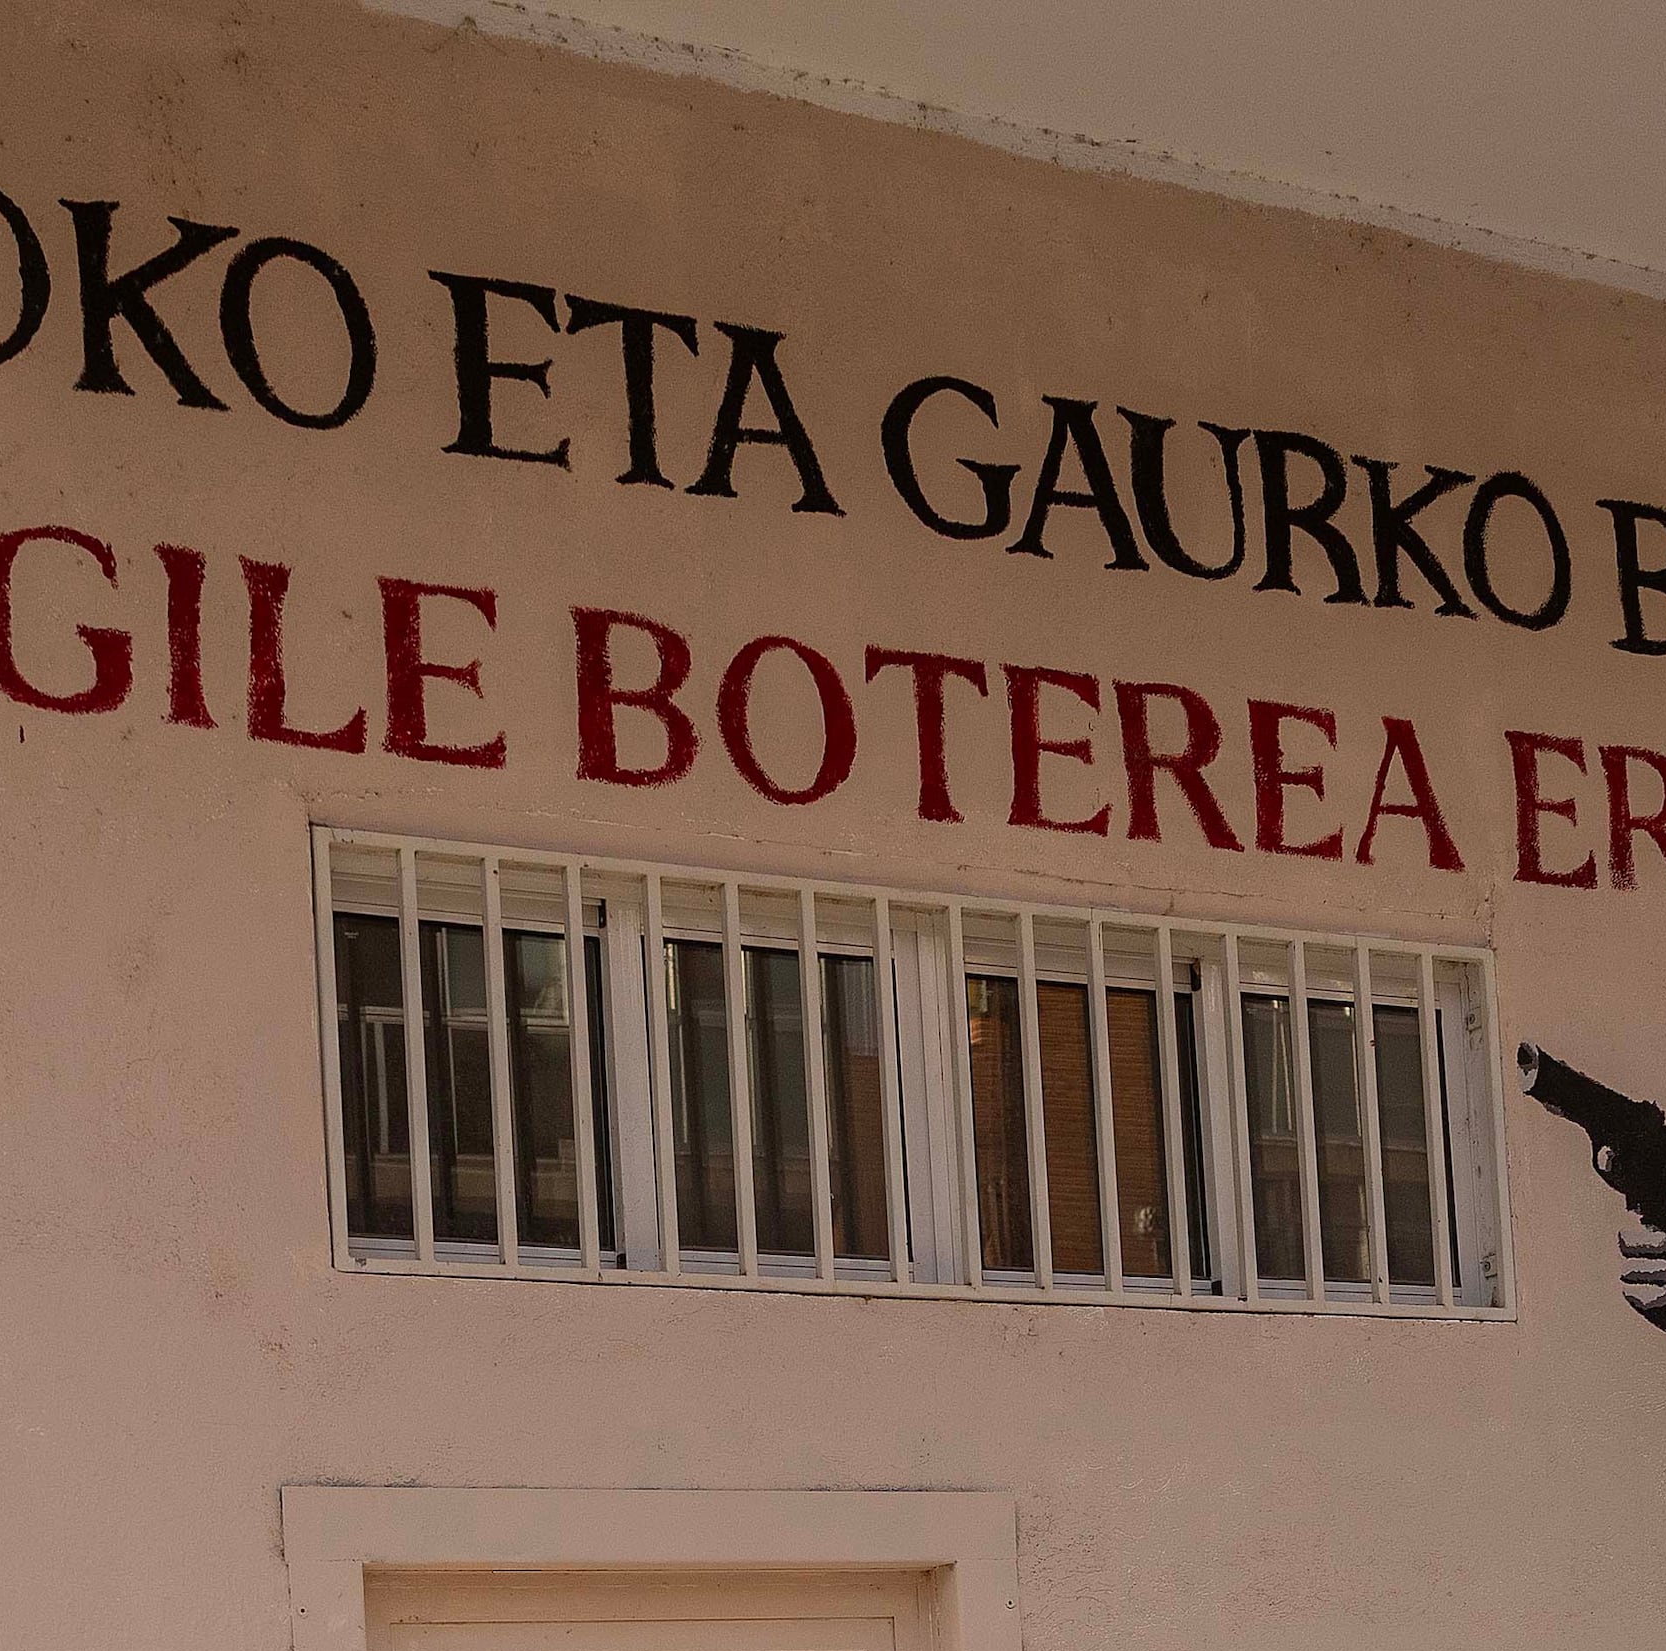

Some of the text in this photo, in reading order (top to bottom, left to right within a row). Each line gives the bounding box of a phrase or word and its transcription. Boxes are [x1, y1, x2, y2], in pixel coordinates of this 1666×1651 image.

[428, 271, 845, 516] ETA
[881, 375, 1572, 632] GAURKO
[573, 606, 1465, 873] BOTEREA
